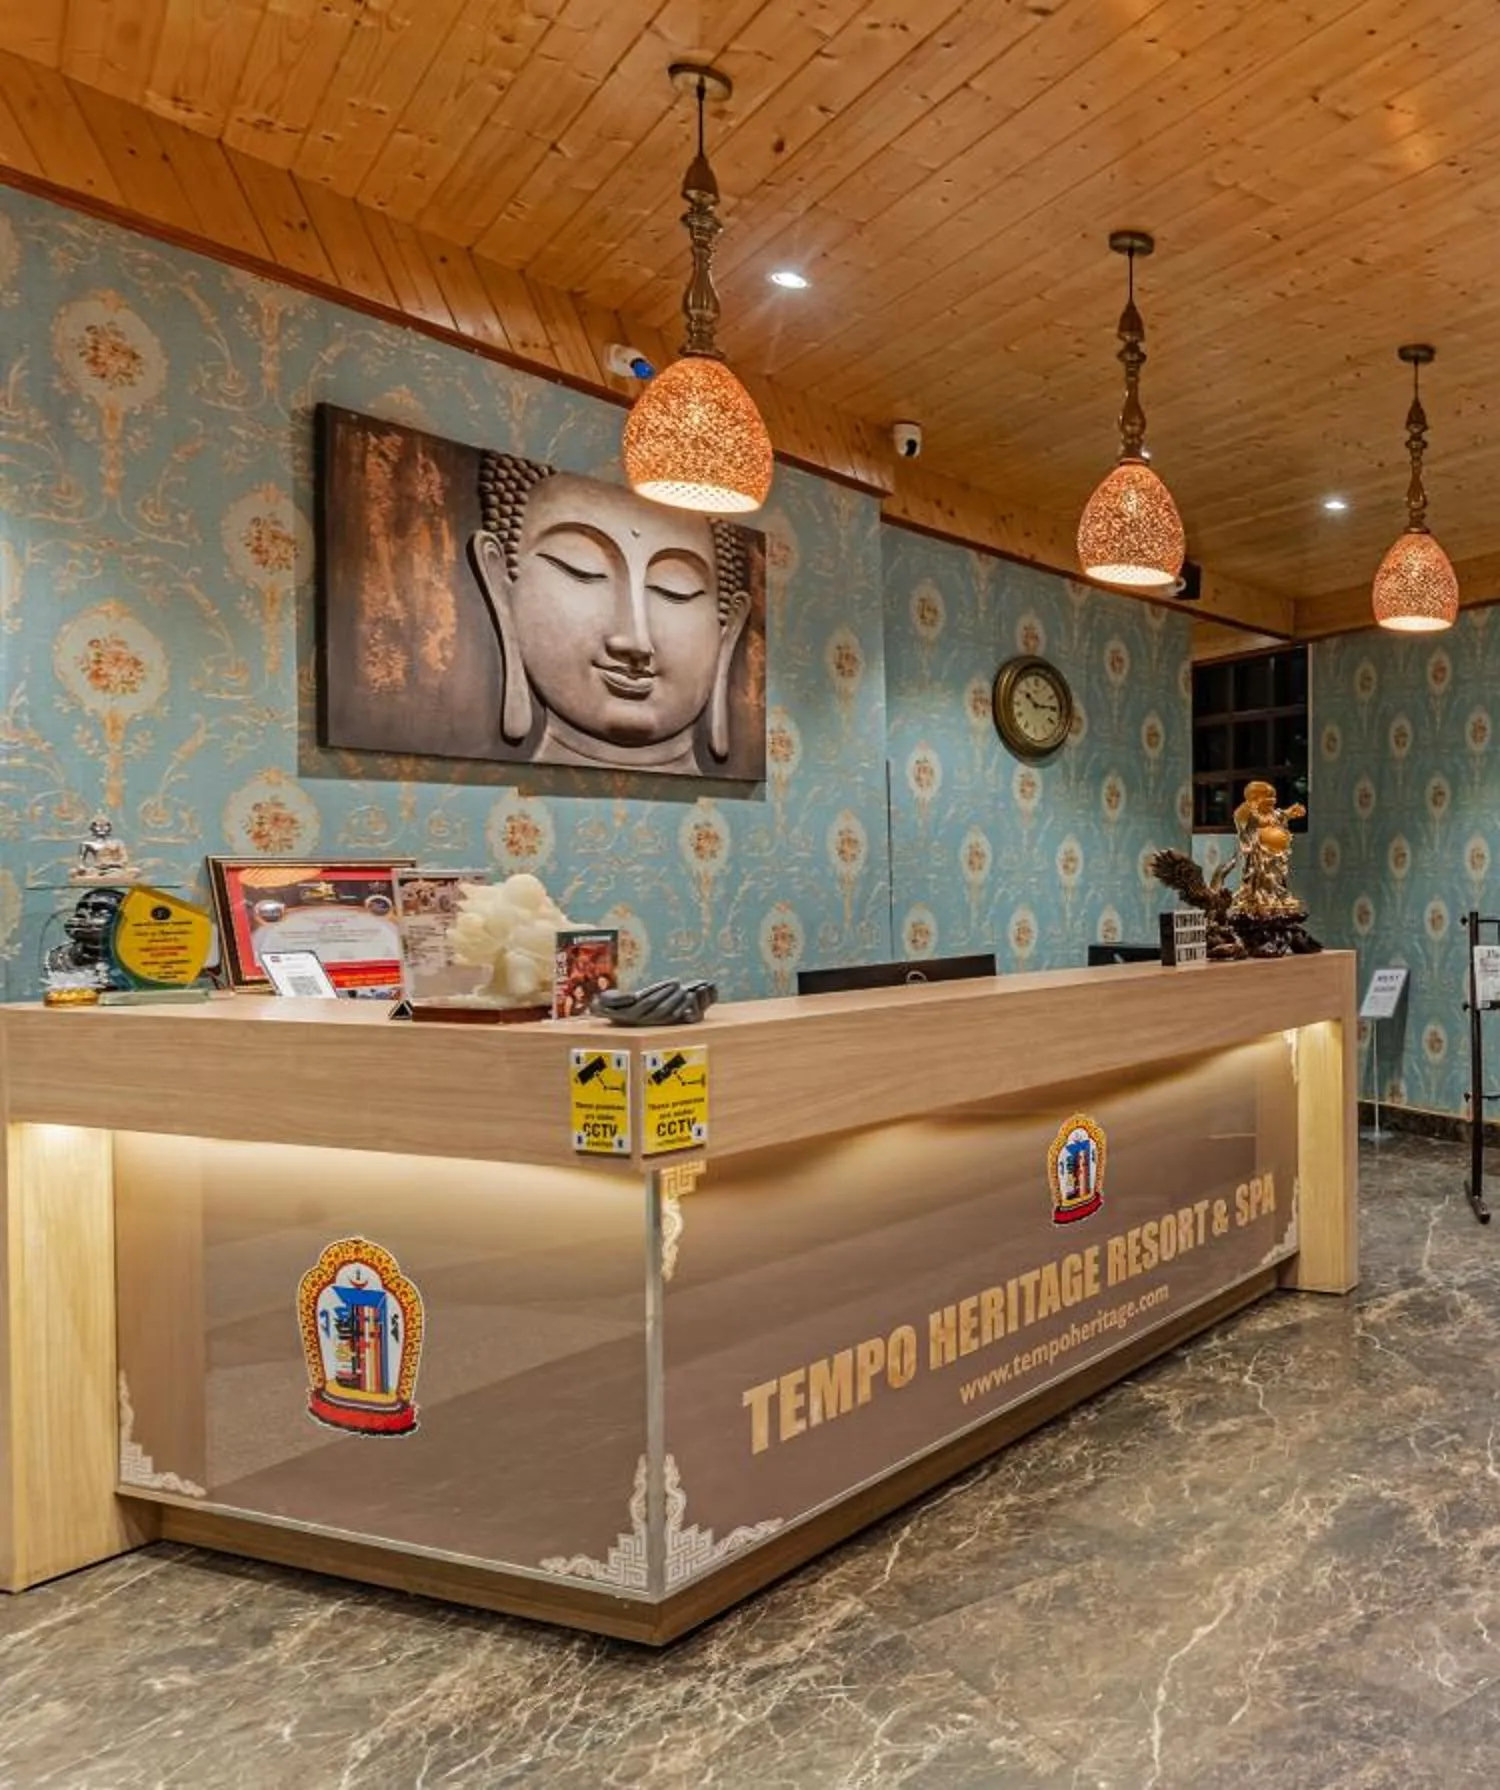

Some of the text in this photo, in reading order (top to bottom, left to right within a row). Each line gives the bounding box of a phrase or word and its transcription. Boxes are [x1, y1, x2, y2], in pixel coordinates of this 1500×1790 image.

[583, 1122, 618, 1138] CCTV
[656, 1116, 697, 1137] CCTV
[742, 1172, 1276, 1455] TEMPO HERITAGE RESORT & SPA
[959, 1284, 1170, 1405] www.tempoheritage.com
